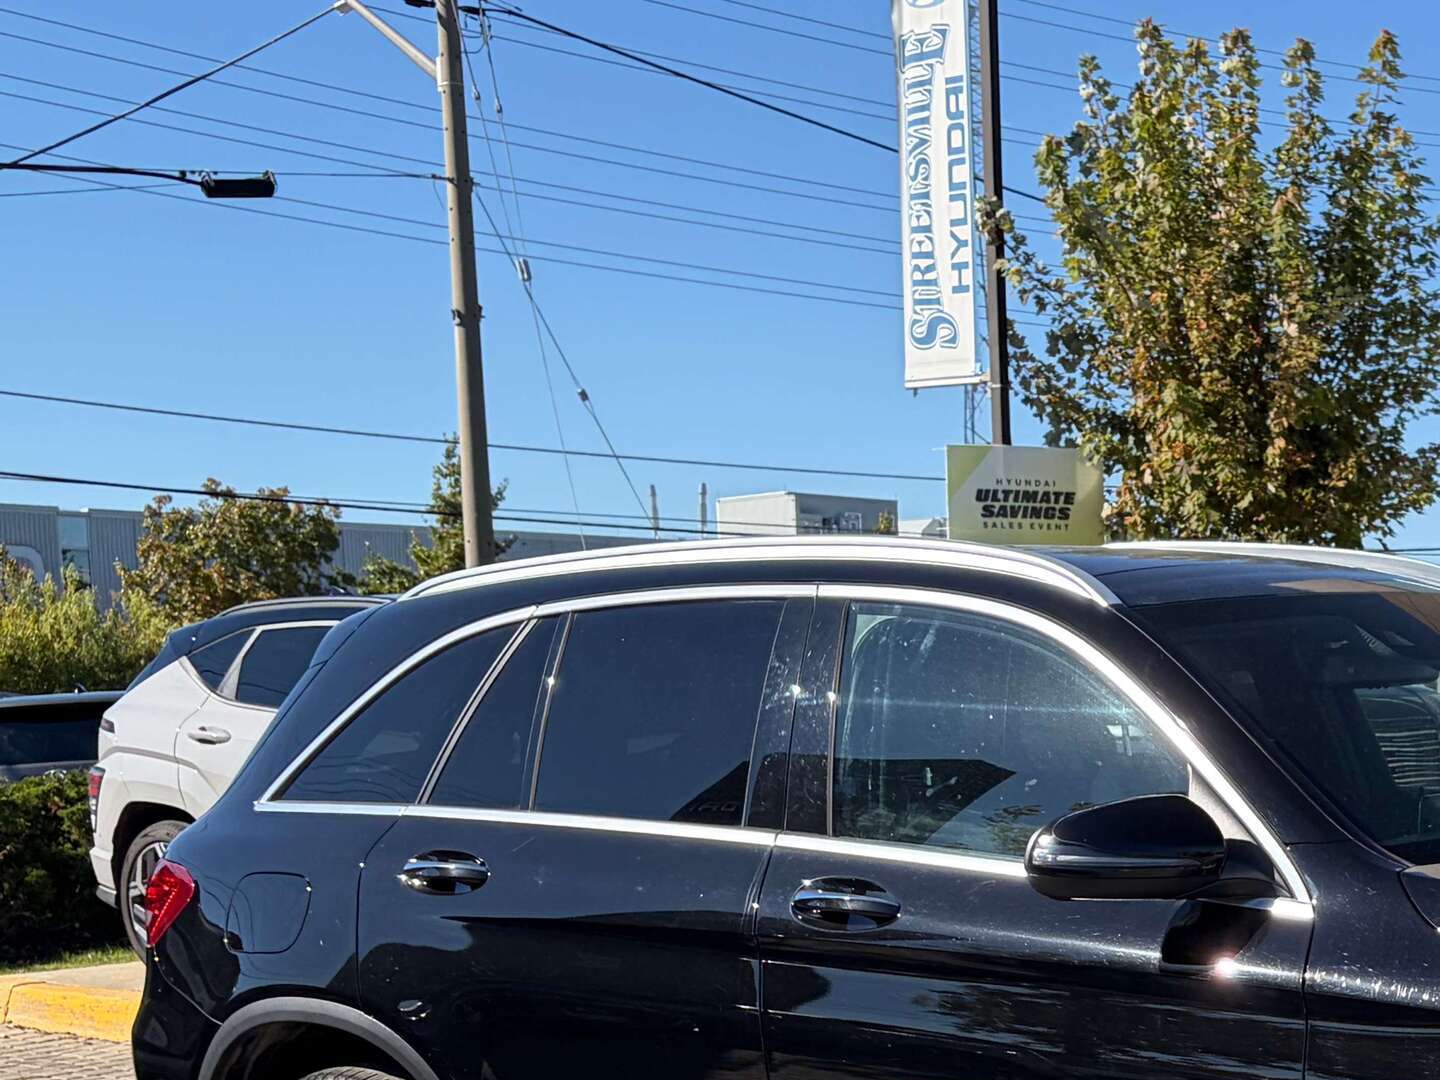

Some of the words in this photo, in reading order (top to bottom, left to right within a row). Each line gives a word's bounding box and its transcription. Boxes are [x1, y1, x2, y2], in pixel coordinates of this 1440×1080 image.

[899, 24, 960, 350] STREETSVILLE
[945, 74, 970, 295] HYUNDAI
[995, 478, 1056, 487] HYUNDAI
[975, 488, 1076, 506] ULTIMATE
[980, 504, 1071, 521] SAVINGS
[983, 521, 1024, 530] SALES
[1030, 522, 1070, 531] EVENT
